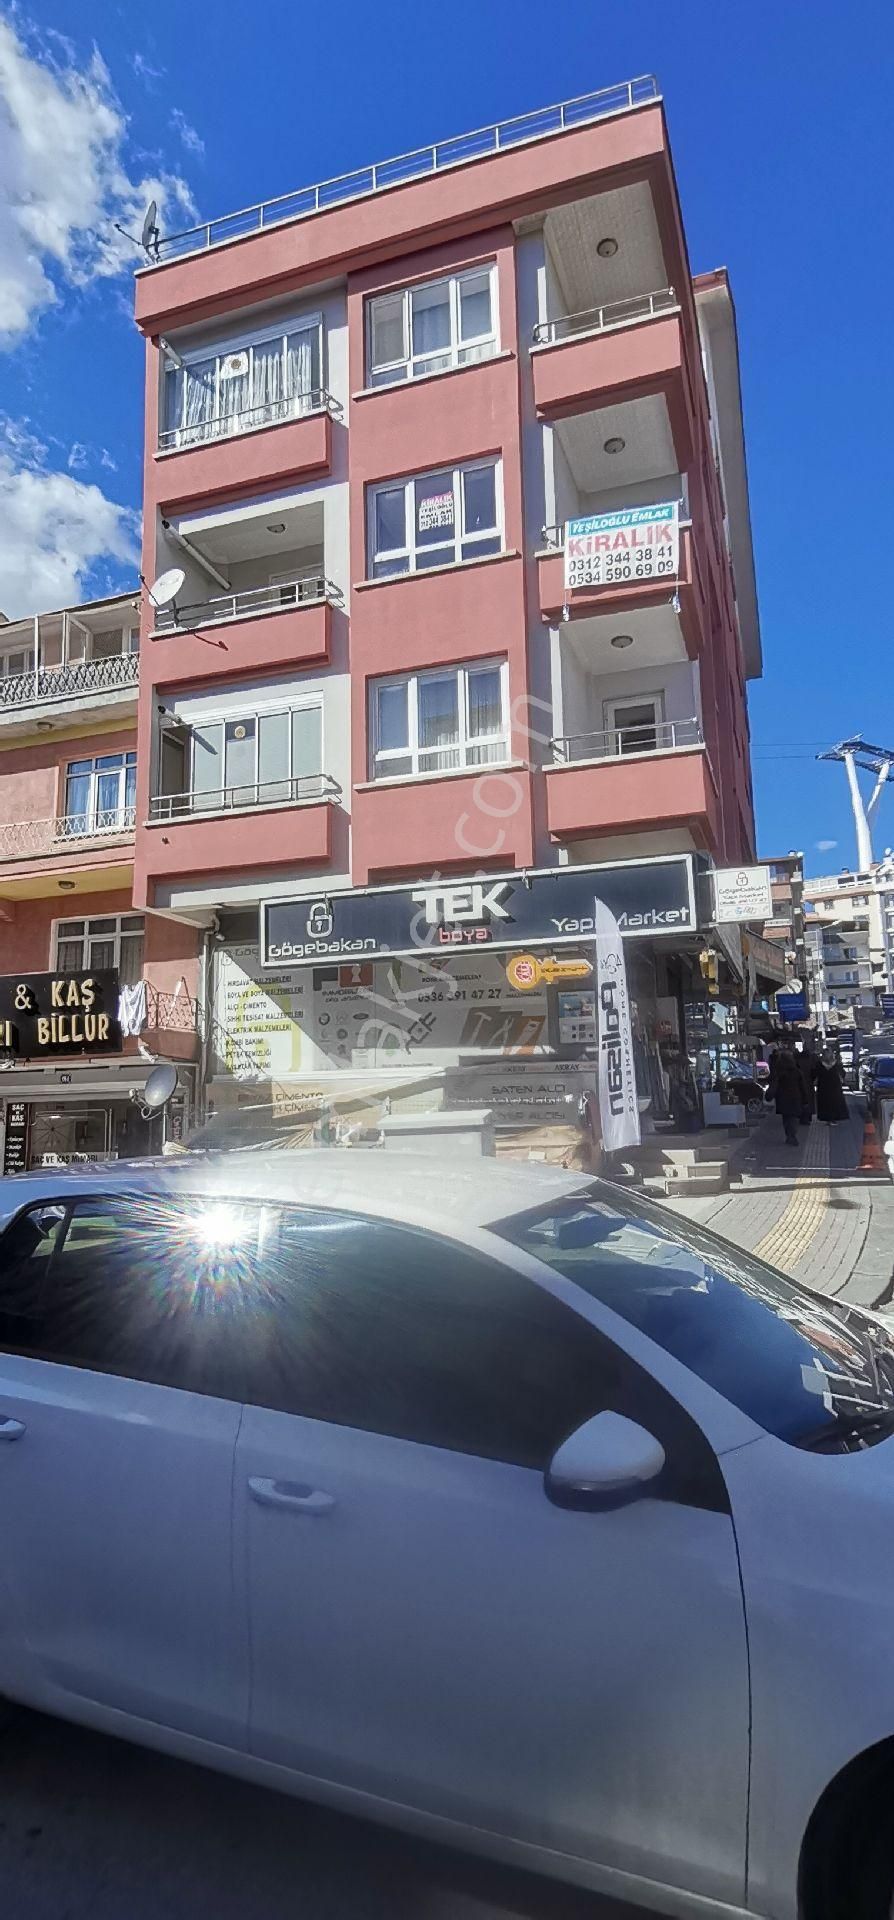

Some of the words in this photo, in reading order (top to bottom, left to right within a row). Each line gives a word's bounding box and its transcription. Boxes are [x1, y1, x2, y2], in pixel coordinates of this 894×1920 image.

[631, 508, 670, 523] EMLAK
[569, 556, 600, 572] 0312
[606, 552, 631, 566] 344
[635, 548, 652, 561] 38
[657, 545, 673, 558] 41
[569, 571, 600, 586] 0534
[606, 566, 631, 581] 590
[636, 563, 652, 576] 69
[657, 560, 674, 573] 09
[411, 882, 512, 923] TEK
[438, 927, 488, 944] boya
[268, 937, 376, 958] Gögebakan
[15, 984, 32, 1010] &
[51, 978, 96, 1013] KAŞ
[488, 988, 502, 999] 27
